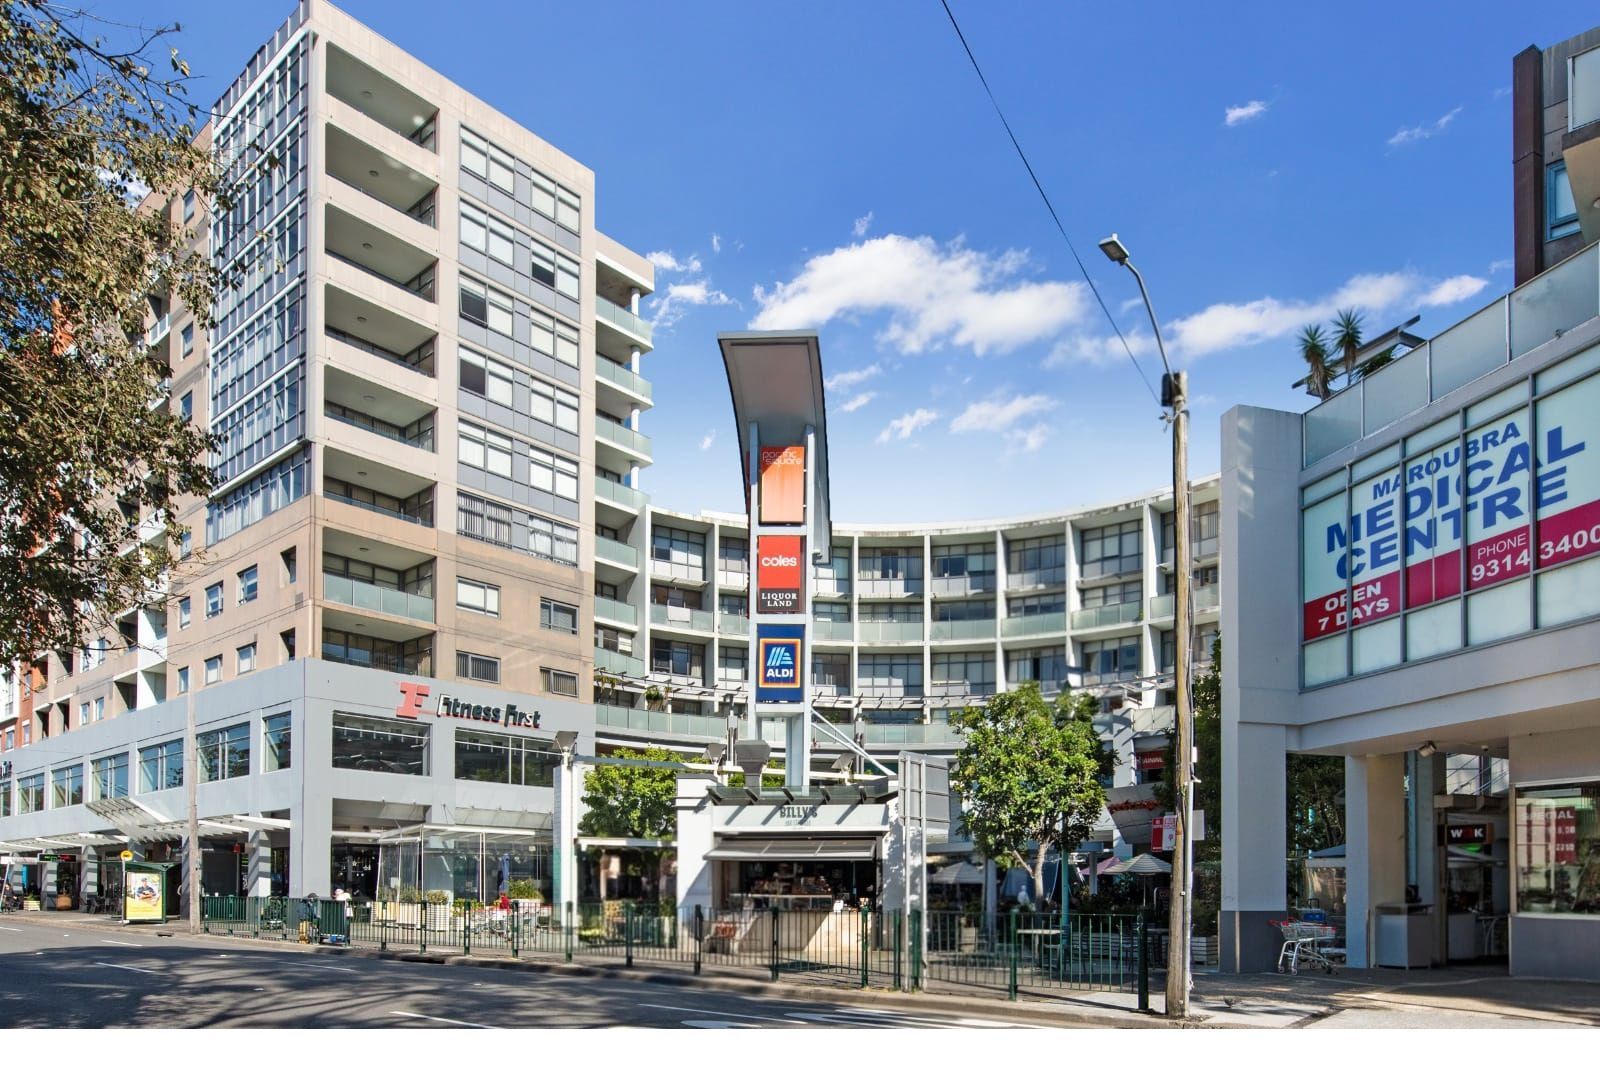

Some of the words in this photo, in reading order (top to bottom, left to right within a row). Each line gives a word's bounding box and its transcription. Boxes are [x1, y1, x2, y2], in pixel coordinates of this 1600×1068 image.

[1372, 421, 1521, 500] MAROUBRA
[1326, 425, 1586, 554] MEDICAL
[1335, 465, 1568, 581] CENTRE
[761, 555, 798, 567] coles
[1471, 549, 1532, 582] 9314
[1539, 524, 1600, 561] 3400
[1477, 532, 1527, 560] PHONE
[761, 592, 798, 601] LIQUOR
[1324, 581, 1382, 612] OPEN
[1318, 615, 1330, 631] 7
[1335, 597, 1390, 627] DAYS
[766, 668, 794, 678] ALDI
[436, 693, 502, 723] Fitness
[503, 702, 542, 729] First
